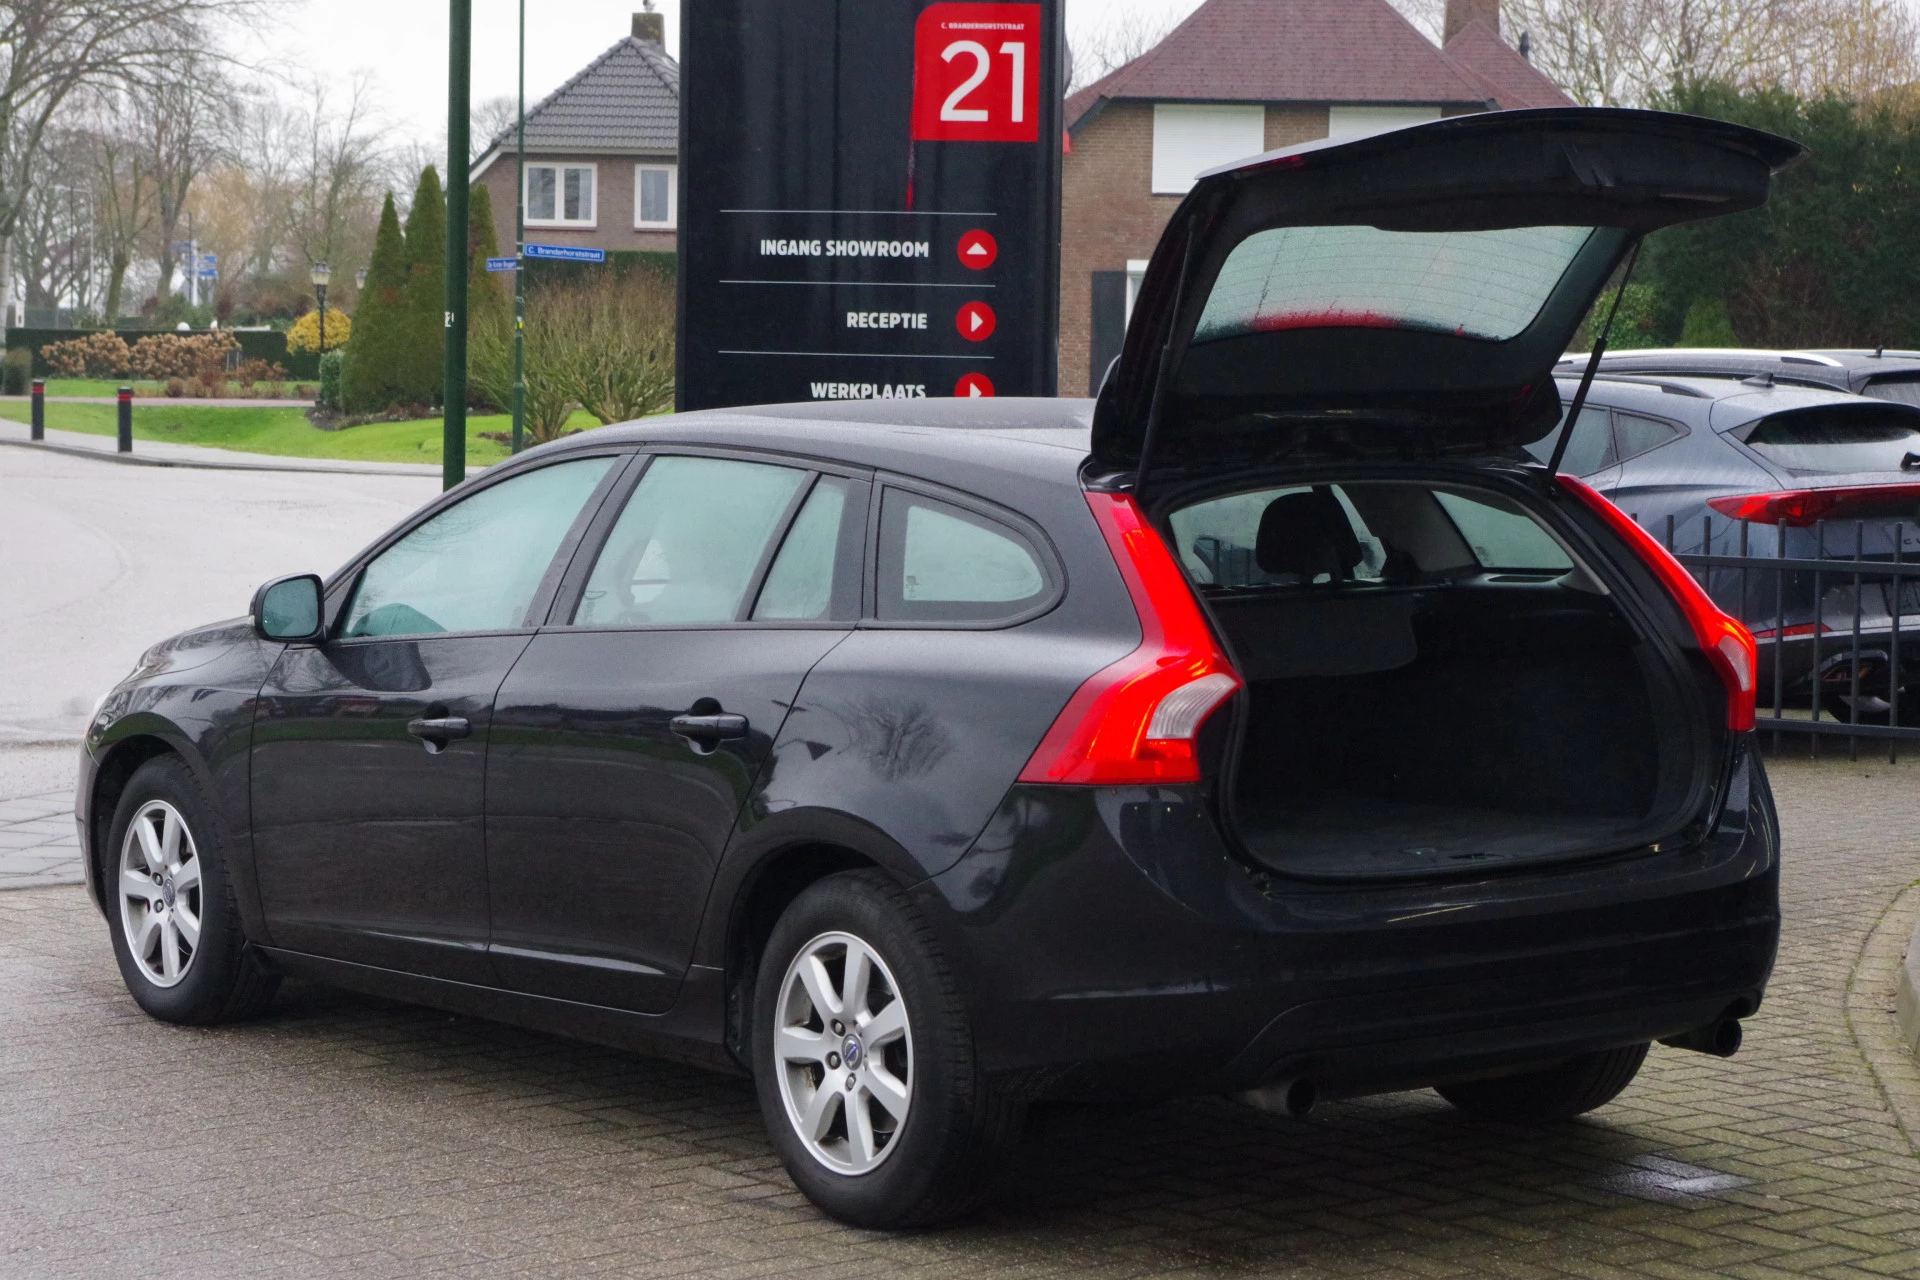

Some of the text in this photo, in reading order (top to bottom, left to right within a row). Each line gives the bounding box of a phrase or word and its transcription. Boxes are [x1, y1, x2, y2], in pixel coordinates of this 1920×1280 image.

[940, 40, 1025, 123] 21
[760, 239, 929, 258] INGANG SHOWROOM
[846, 312, 928, 329] RECEPTIE
[810, 382, 926, 399] WERKPLAATS
